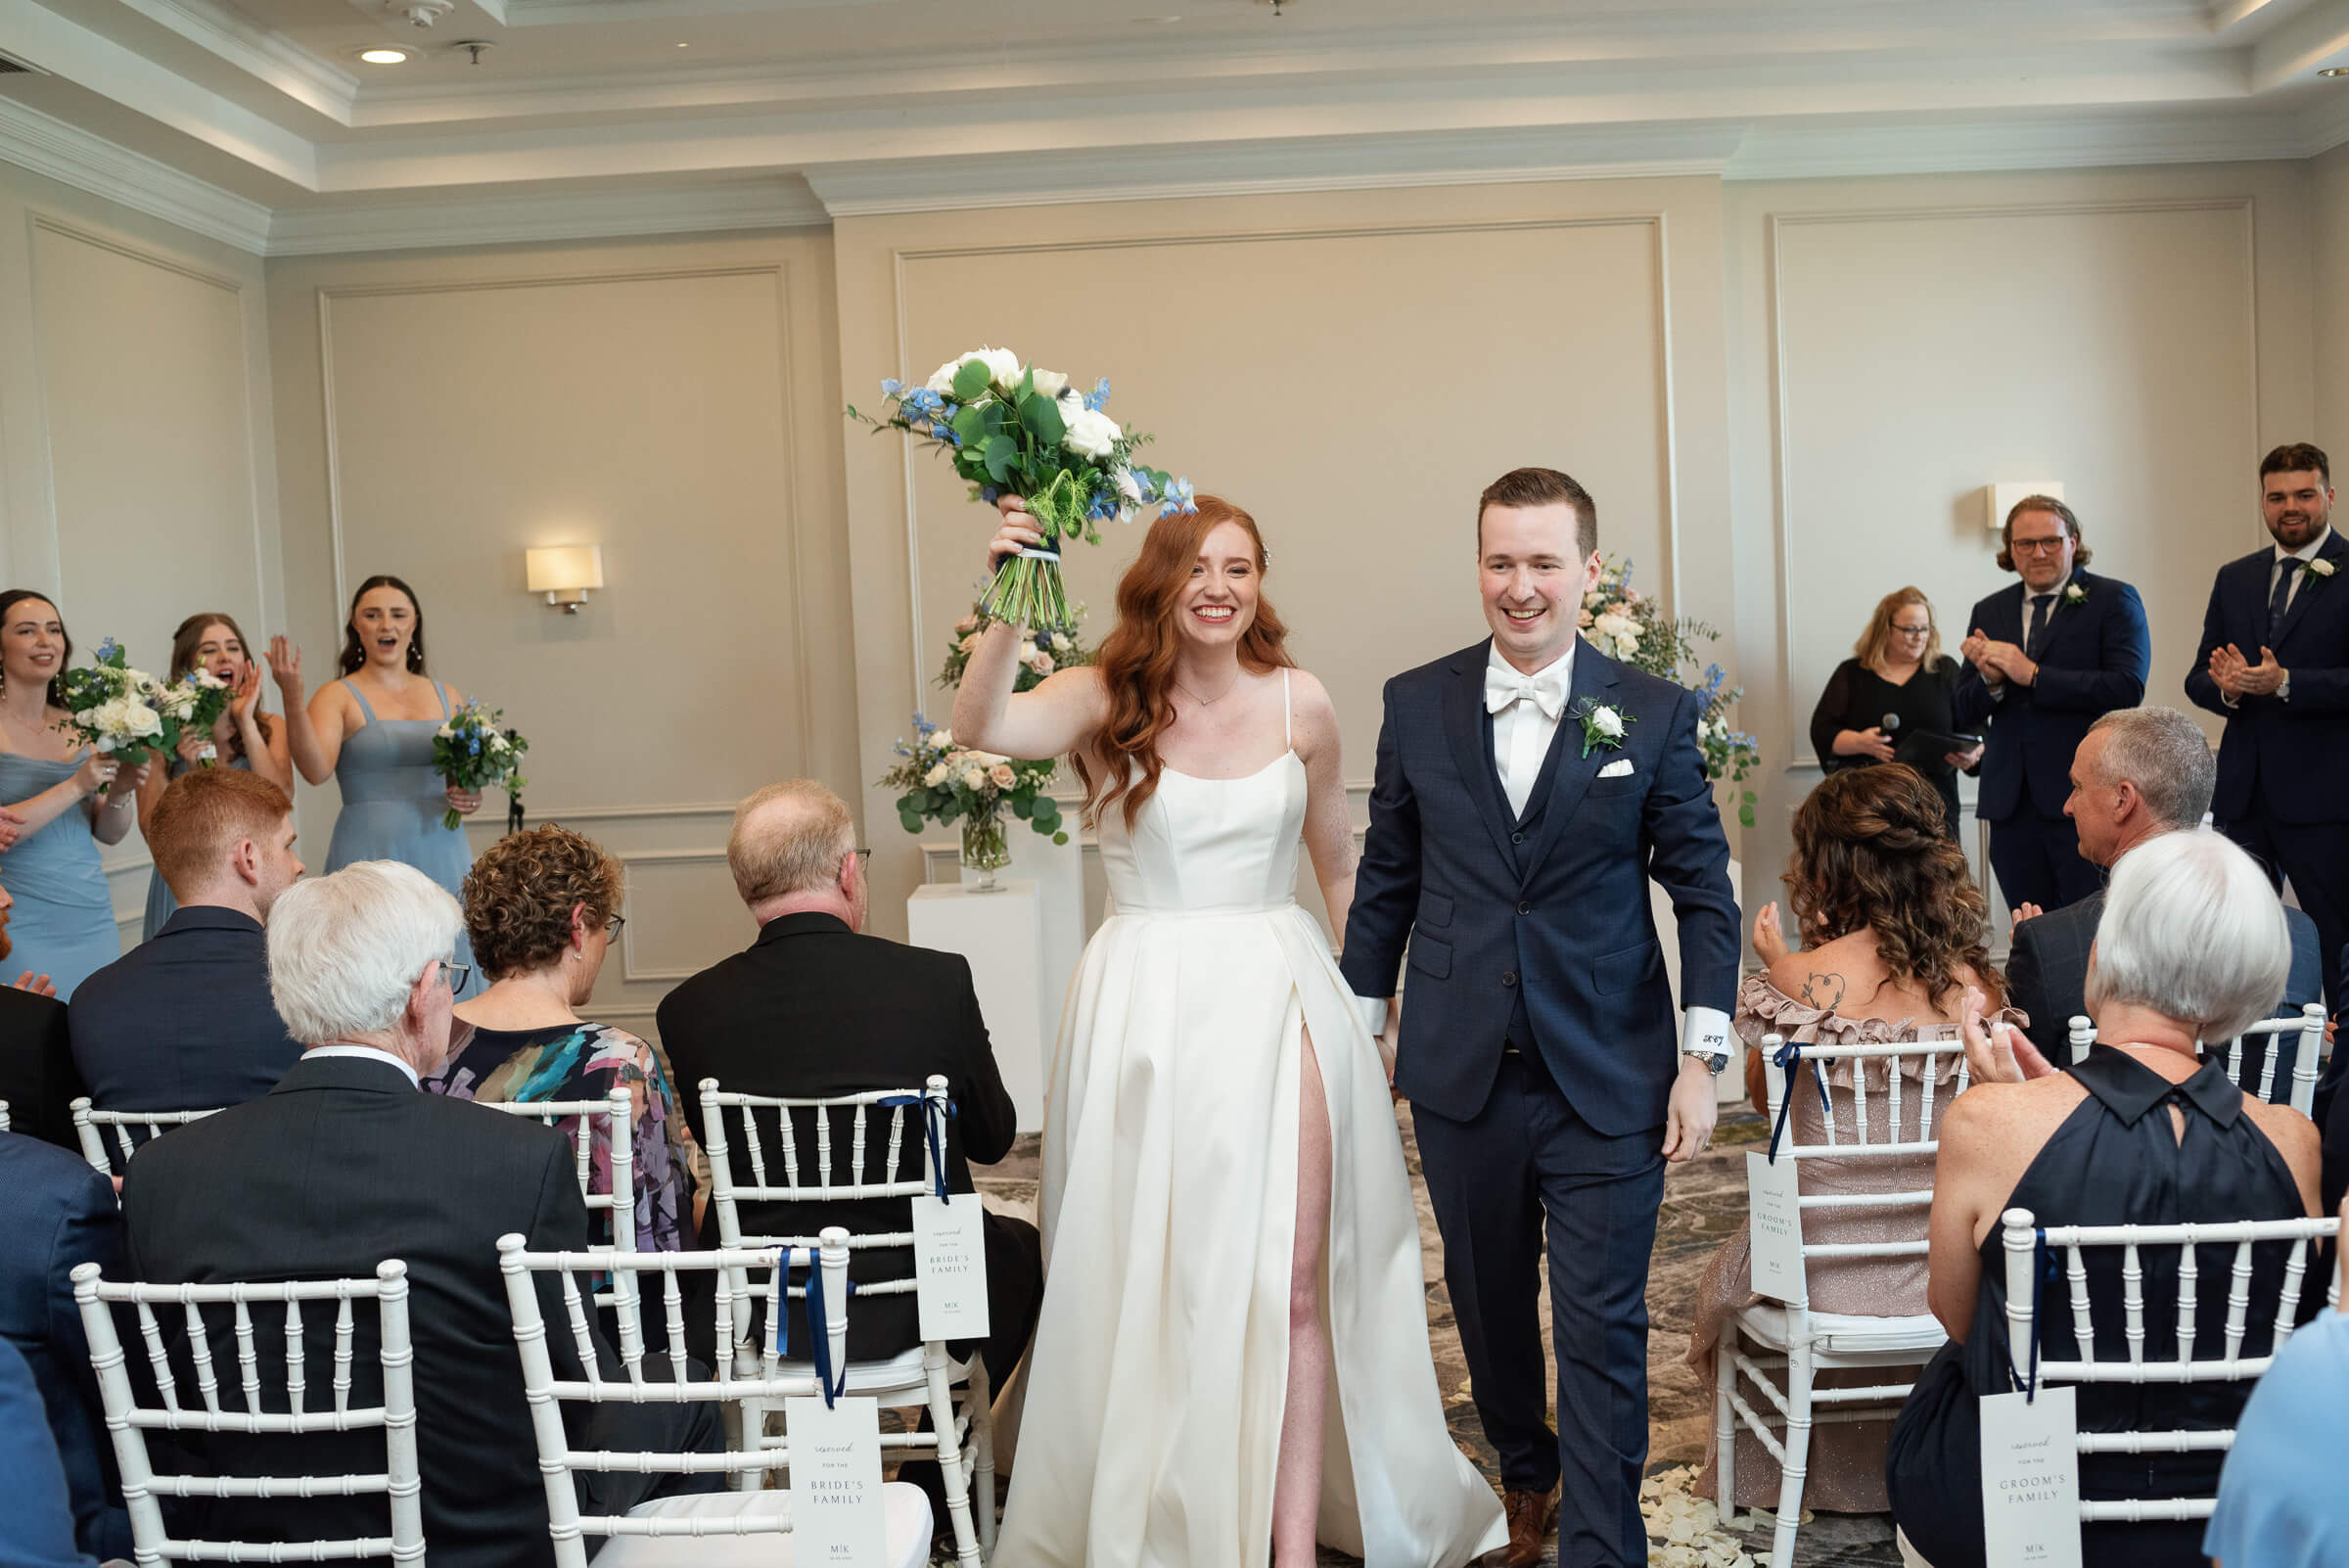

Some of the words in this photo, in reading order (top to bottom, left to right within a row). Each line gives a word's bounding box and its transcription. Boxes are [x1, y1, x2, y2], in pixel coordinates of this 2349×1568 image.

[1758, 1212, 1792, 1227] GROOM'S
[1762, 1223, 1787, 1235] FAMILY
[930, 1254, 969, 1264] BRIDE'S
[932, 1265, 968, 1274] FAMILY
[814, 1441, 854, 1453] reserved
[2011, 1435, 2050, 1450] reserved
[810, 1480, 863, 1490] BRIDE'S
[2000, 1474, 2066, 1490] GROOM'S
[2008, 1490, 2058, 1503] FAMILY
